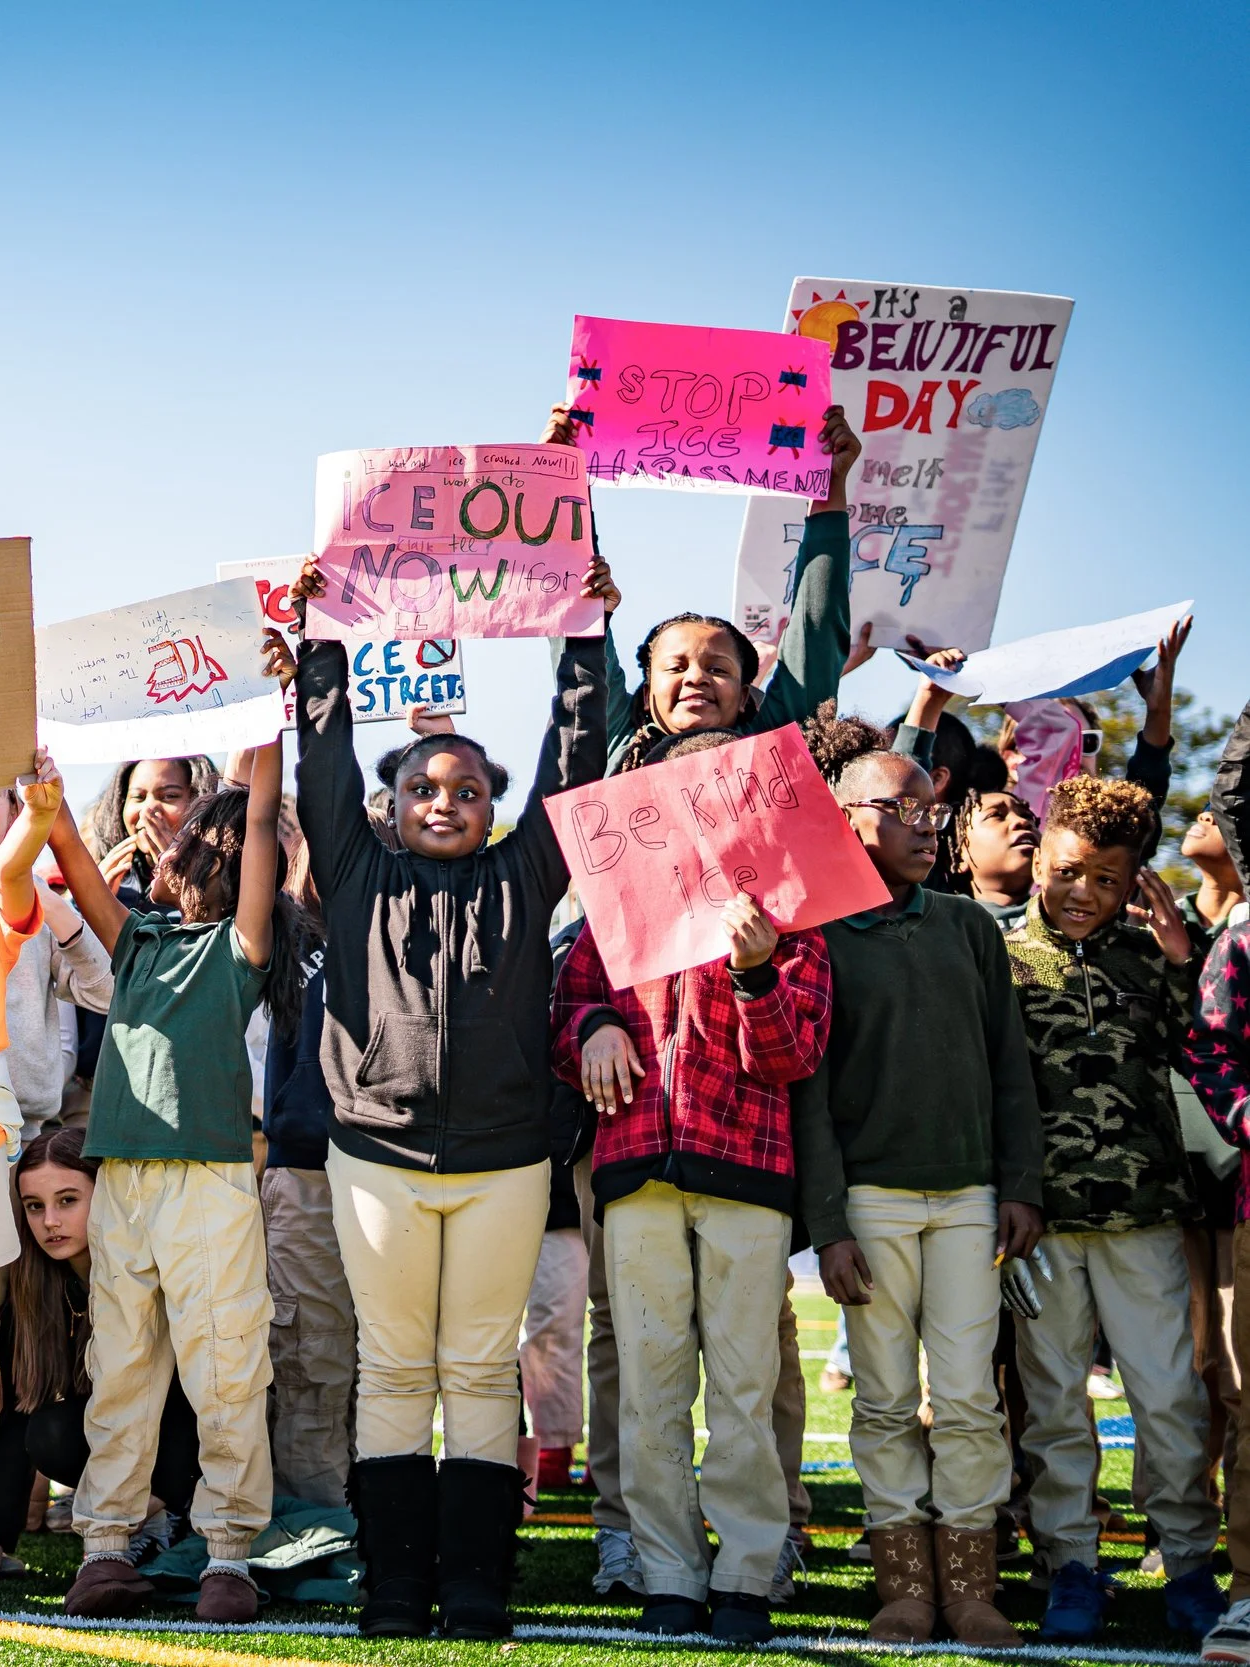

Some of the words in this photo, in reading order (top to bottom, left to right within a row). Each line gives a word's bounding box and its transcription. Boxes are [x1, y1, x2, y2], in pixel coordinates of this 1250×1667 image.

[870, 287, 920, 319] It's
[948, 295, 968, 322] a
[831, 319, 1057, 374] BEAUTIFUL
[617, 364, 772, 425] STOP
[862, 379, 982, 435] DAY
[636, 420, 741, 457] ICE
[587, 449, 831, 497] HARASSMENT!
[458, 482, 588, 547] OUT
[570, 799, 668, 876] Be
[680, 745, 800, 837] kind
[673, 865, 759, 920] ice
